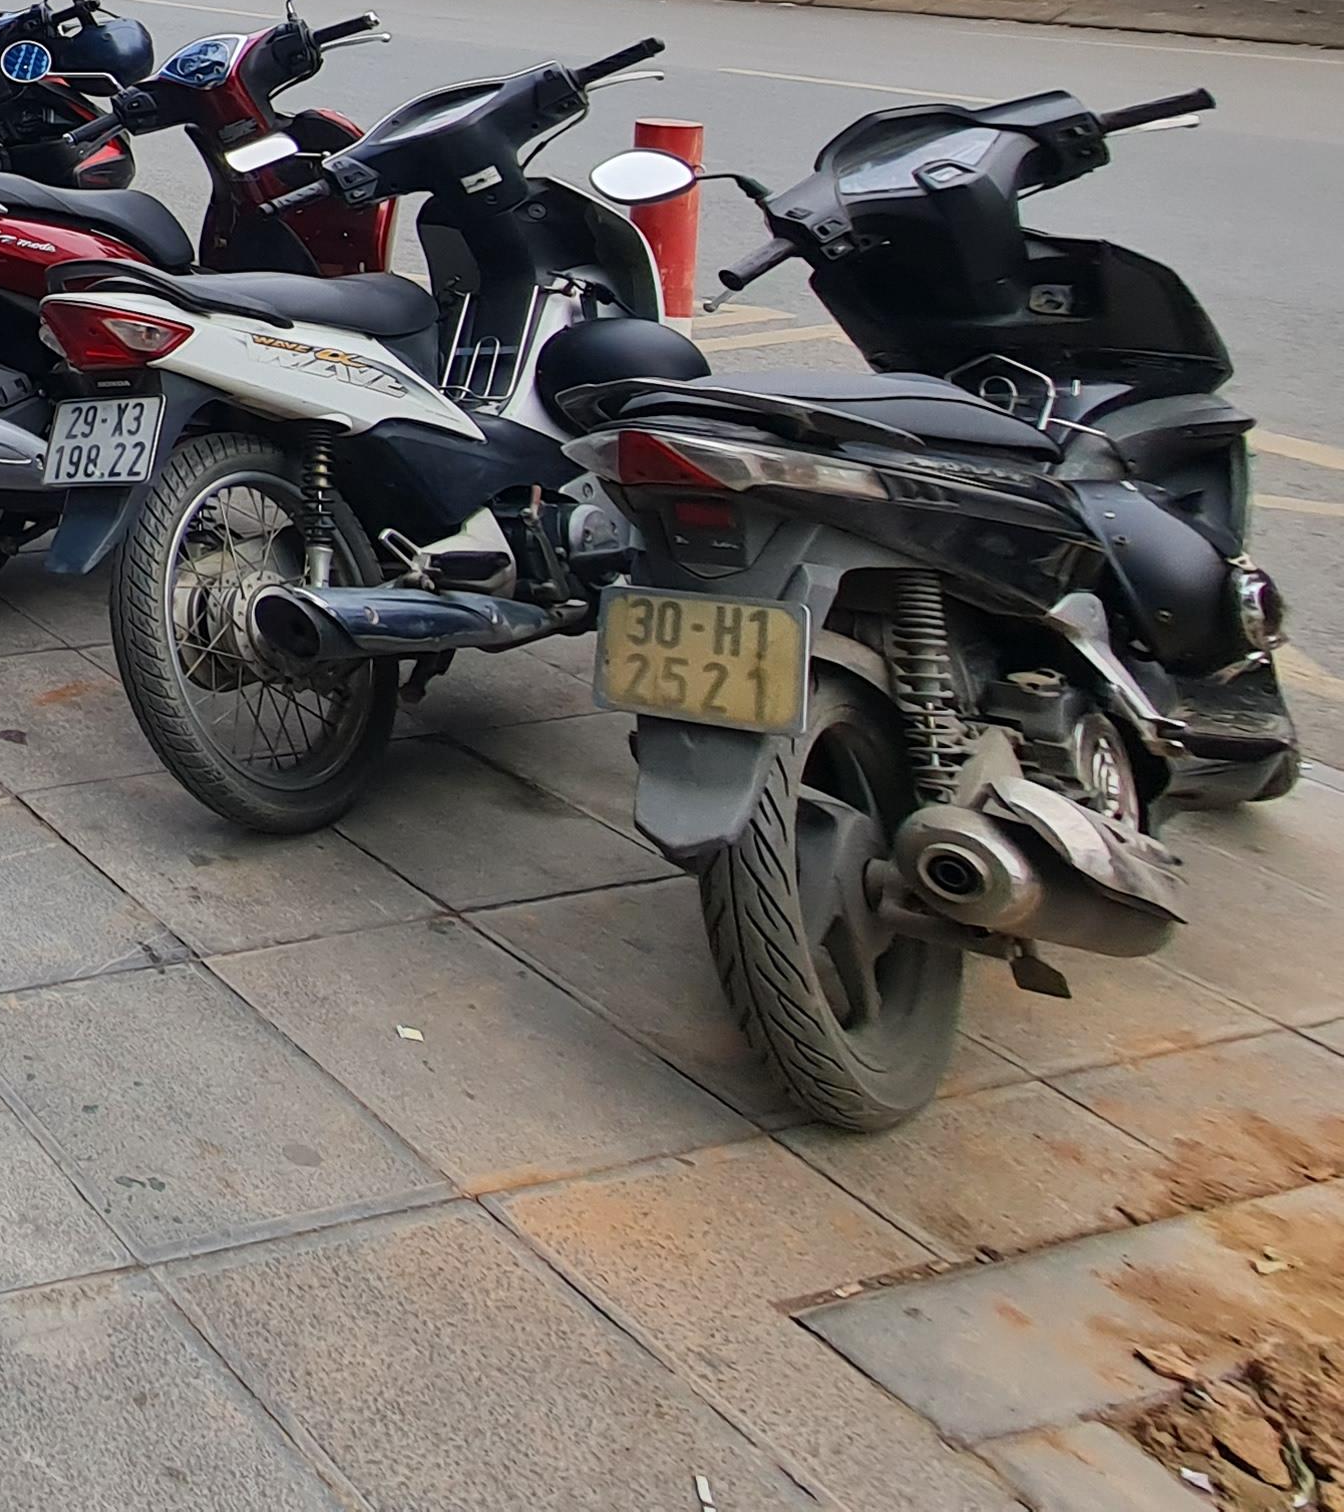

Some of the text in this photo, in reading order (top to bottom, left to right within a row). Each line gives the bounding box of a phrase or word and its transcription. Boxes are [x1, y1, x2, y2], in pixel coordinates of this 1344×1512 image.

[16, 238, 57, 253] mode
[251, 334, 313, 354] WAVE
[65, 402, 145, 440] 29-X3
[54, 441, 146, 480] 198.22
[625, 596, 770, 661] 30-H1
[623, 652, 770, 723] 2521
